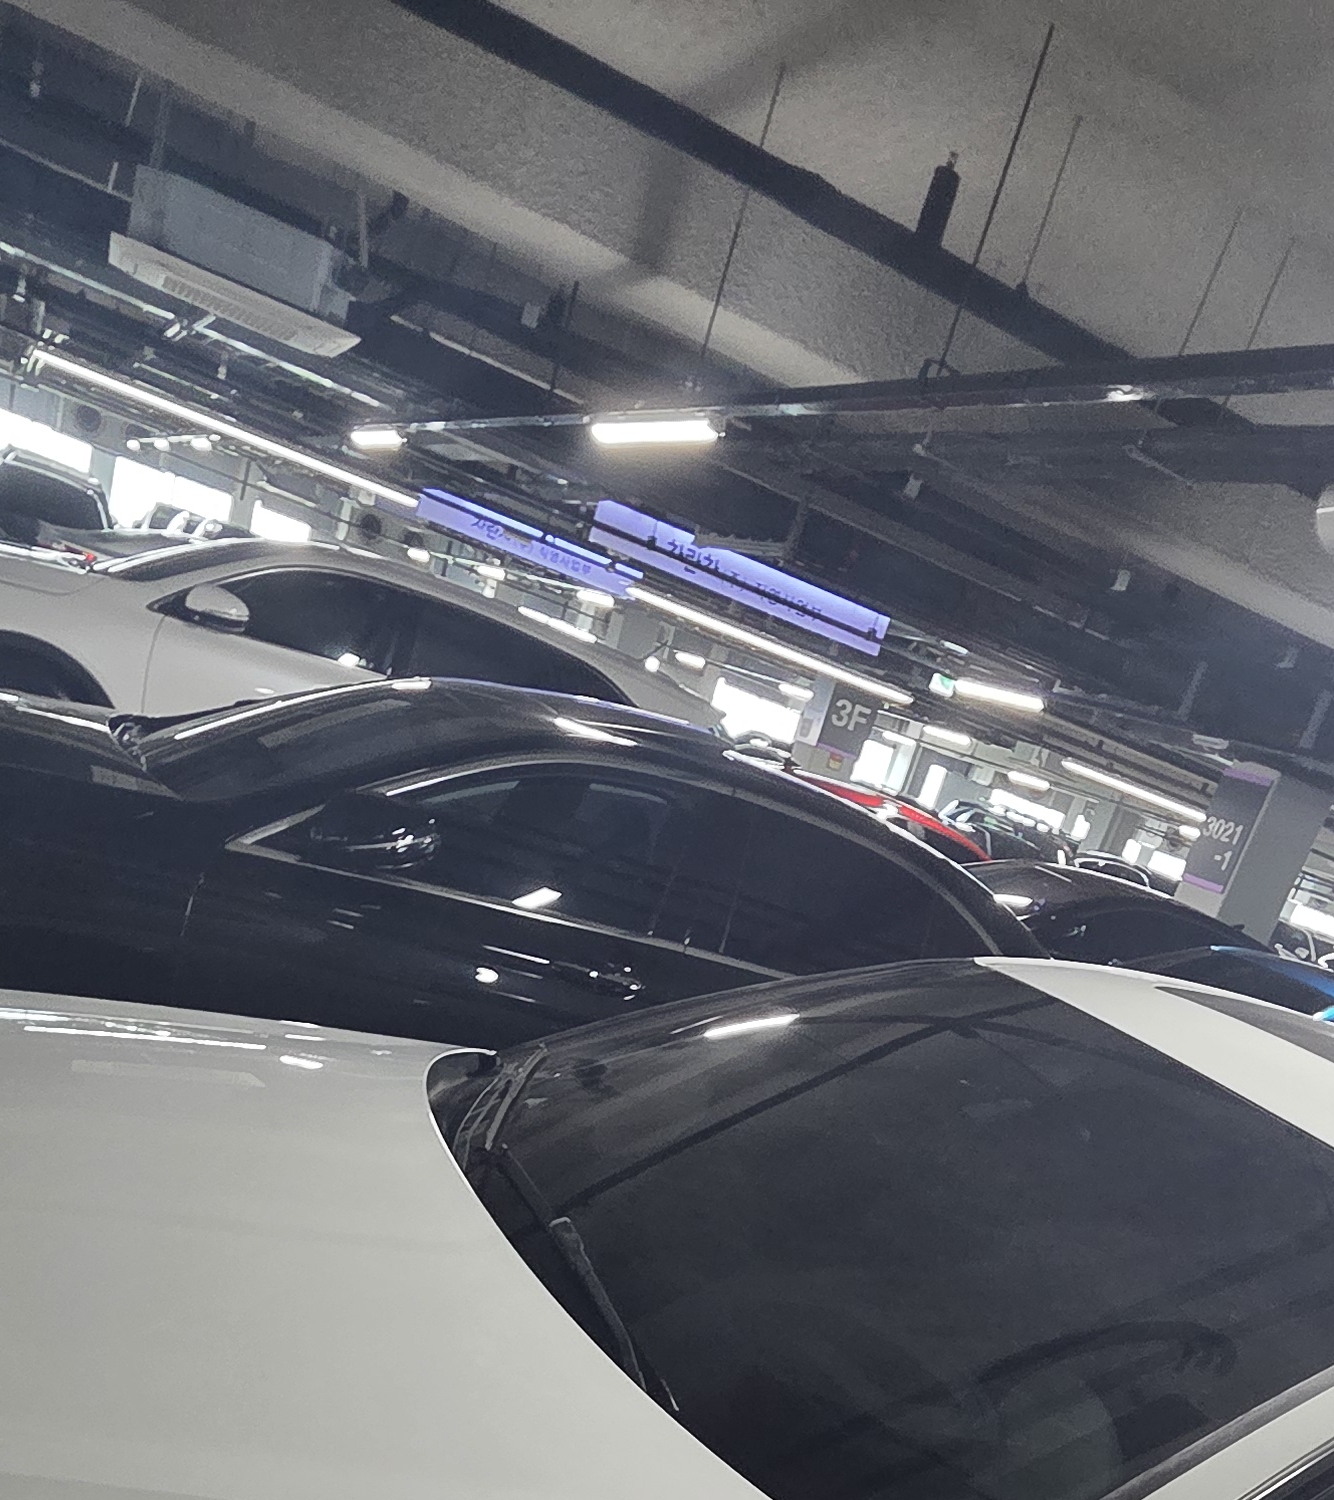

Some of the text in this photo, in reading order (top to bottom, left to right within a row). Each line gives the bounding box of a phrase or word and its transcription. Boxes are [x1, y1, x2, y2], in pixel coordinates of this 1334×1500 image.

[831, 699, 872, 732] 3F
[1202, 816, 1244, 845] 3021
[1214, 850, 1232, 871] -1
